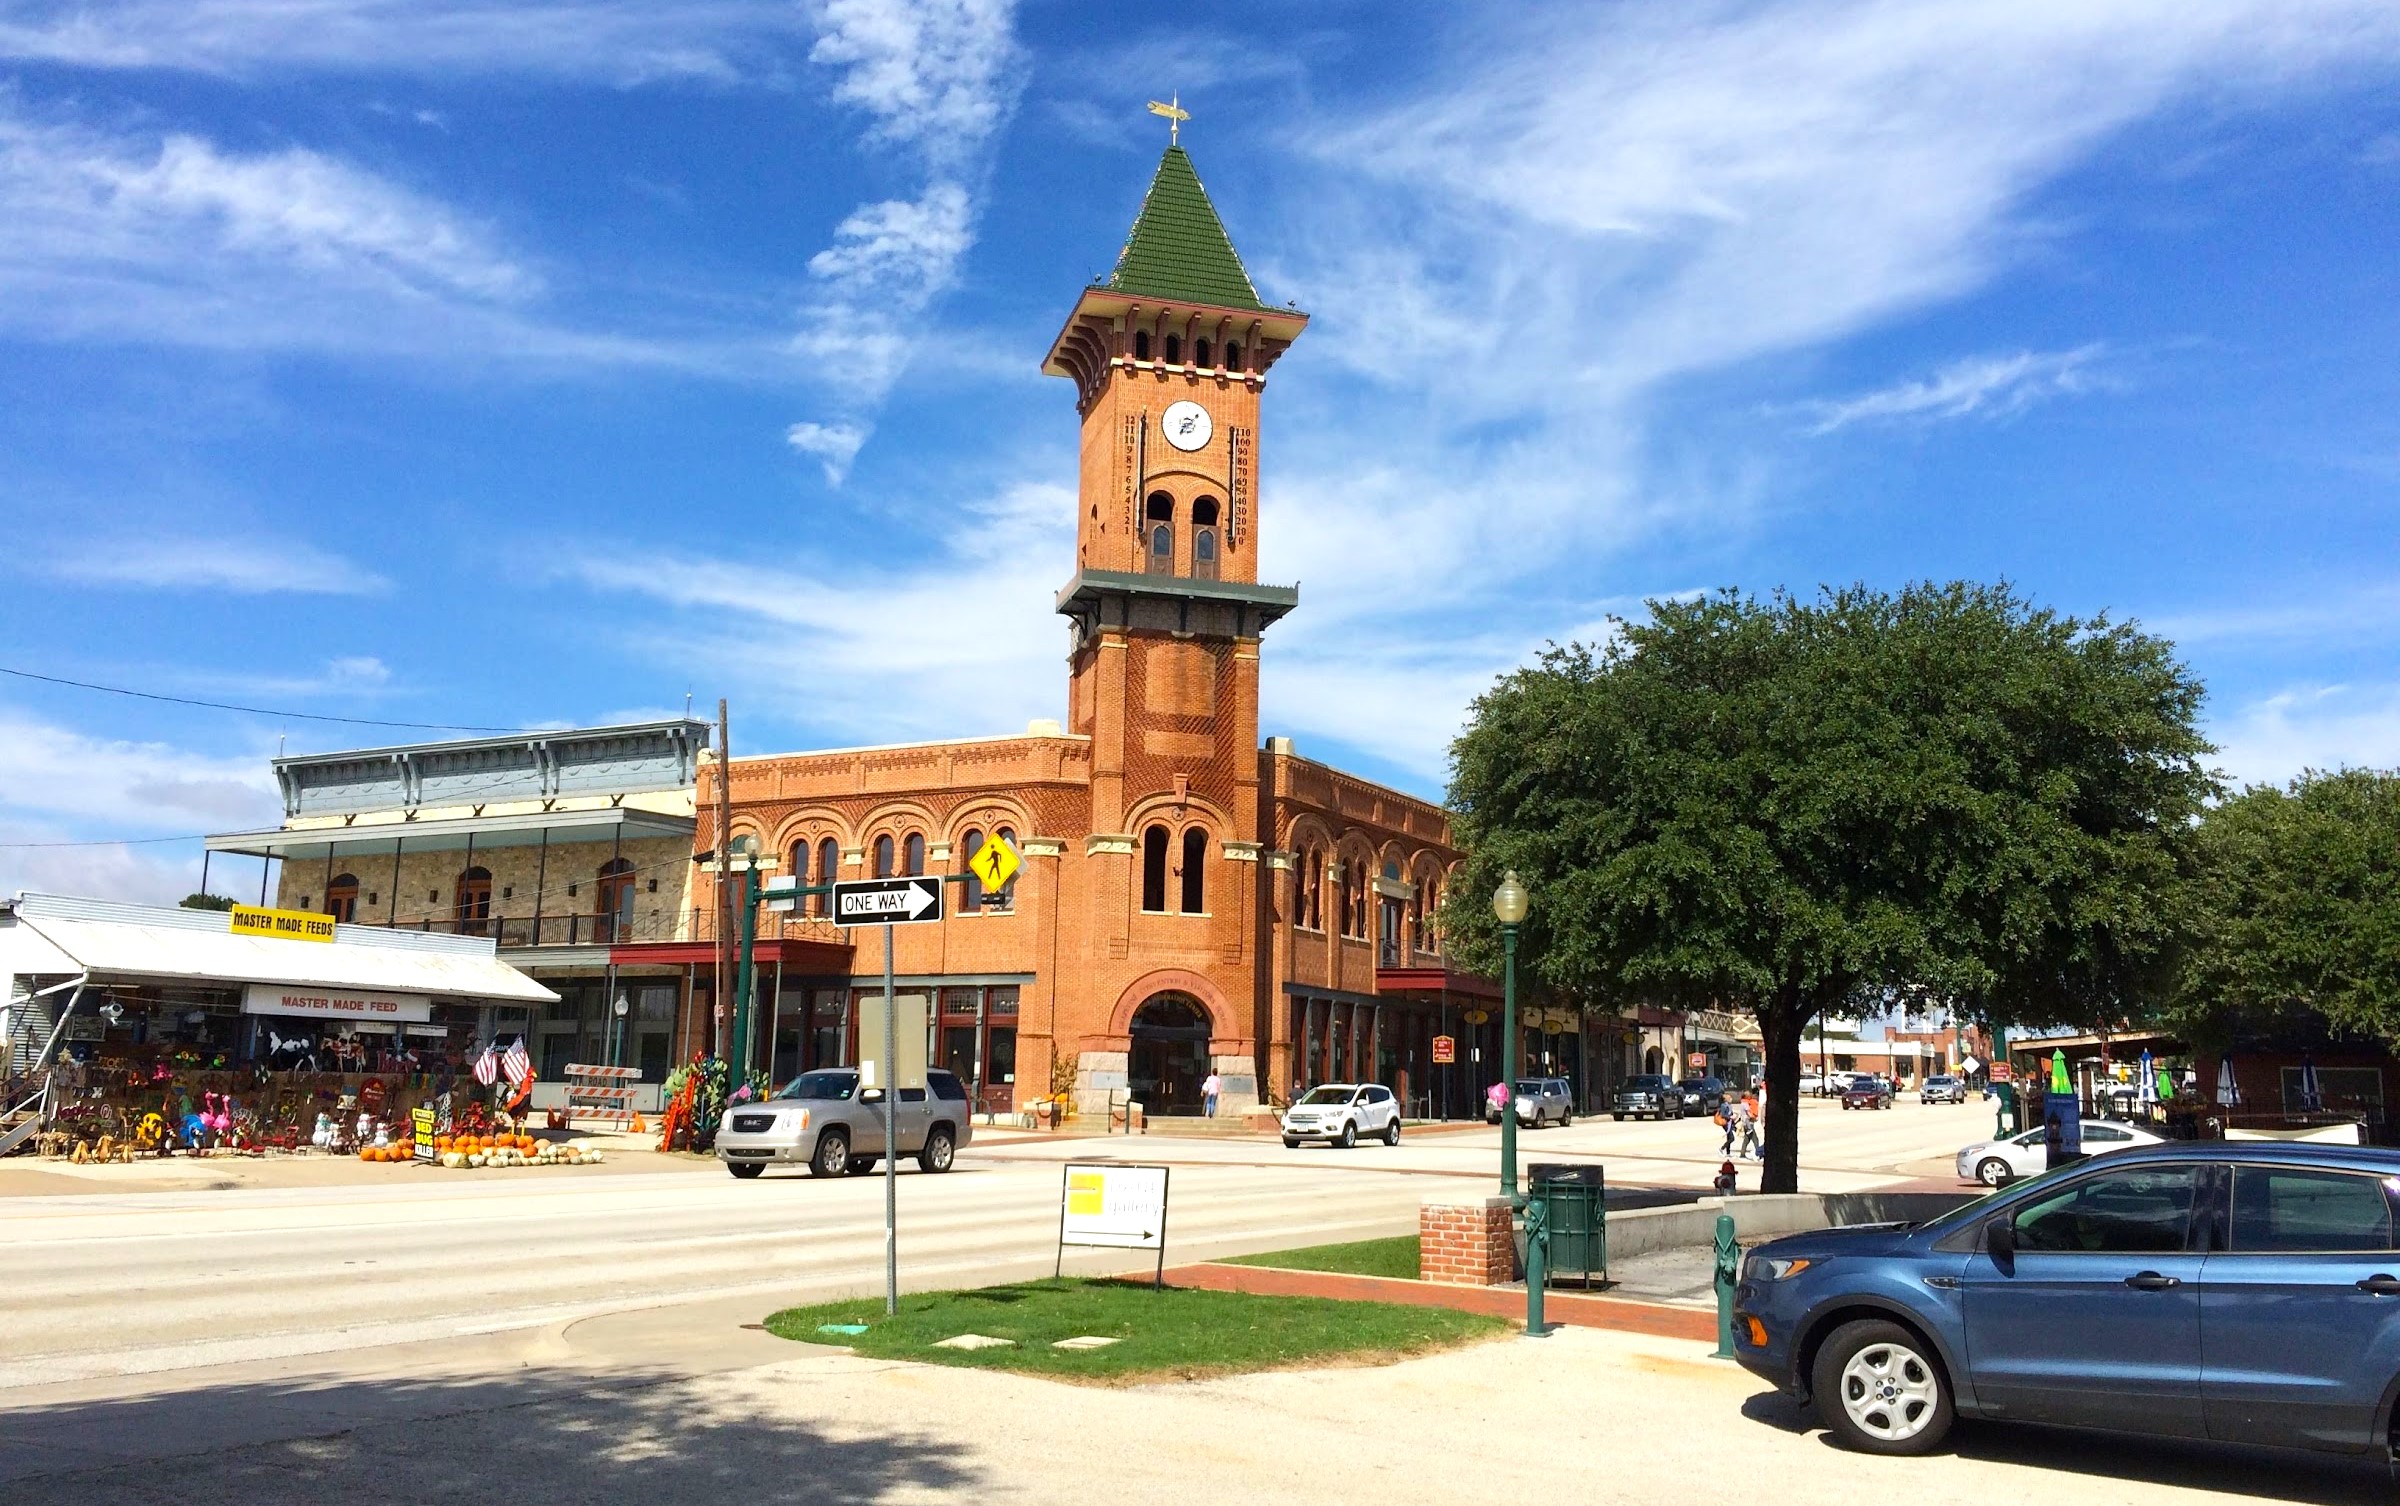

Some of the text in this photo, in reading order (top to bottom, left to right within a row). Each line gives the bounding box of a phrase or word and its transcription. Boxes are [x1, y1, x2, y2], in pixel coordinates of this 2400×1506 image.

[1125, 415, 1135, 424] 12
[1125, 426, 1134, 434] 11
[1236, 428, 1250, 436] 110
[1125, 436, 1134, 444] 10
[1236, 438, 1250, 446] 100
[1127, 446, 1132, 454] 9
[1238, 458, 1248, 466] 80
[1238, 468, 1248, 476] 70
[1126, 476, 1132, 484] 6
[1237, 478, 1248, 486] 60
[1126, 486, 1131, 494] 5
[1236, 507, 1246, 515] 30
[1236, 517, 1246, 525] 20
[1238, 527, 1246, 536] 10
[1239, 537, 1244, 545] 0
[846, 893, 907, 912] ONE WAY
[234, 912, 332, 936] MASTER MADE FEEDS
[282, 996, 398, 1012] MASTER MADE FEED
[416, 1121, 432, 1134] BED
[416, 1132, 433, 1146] BUG
